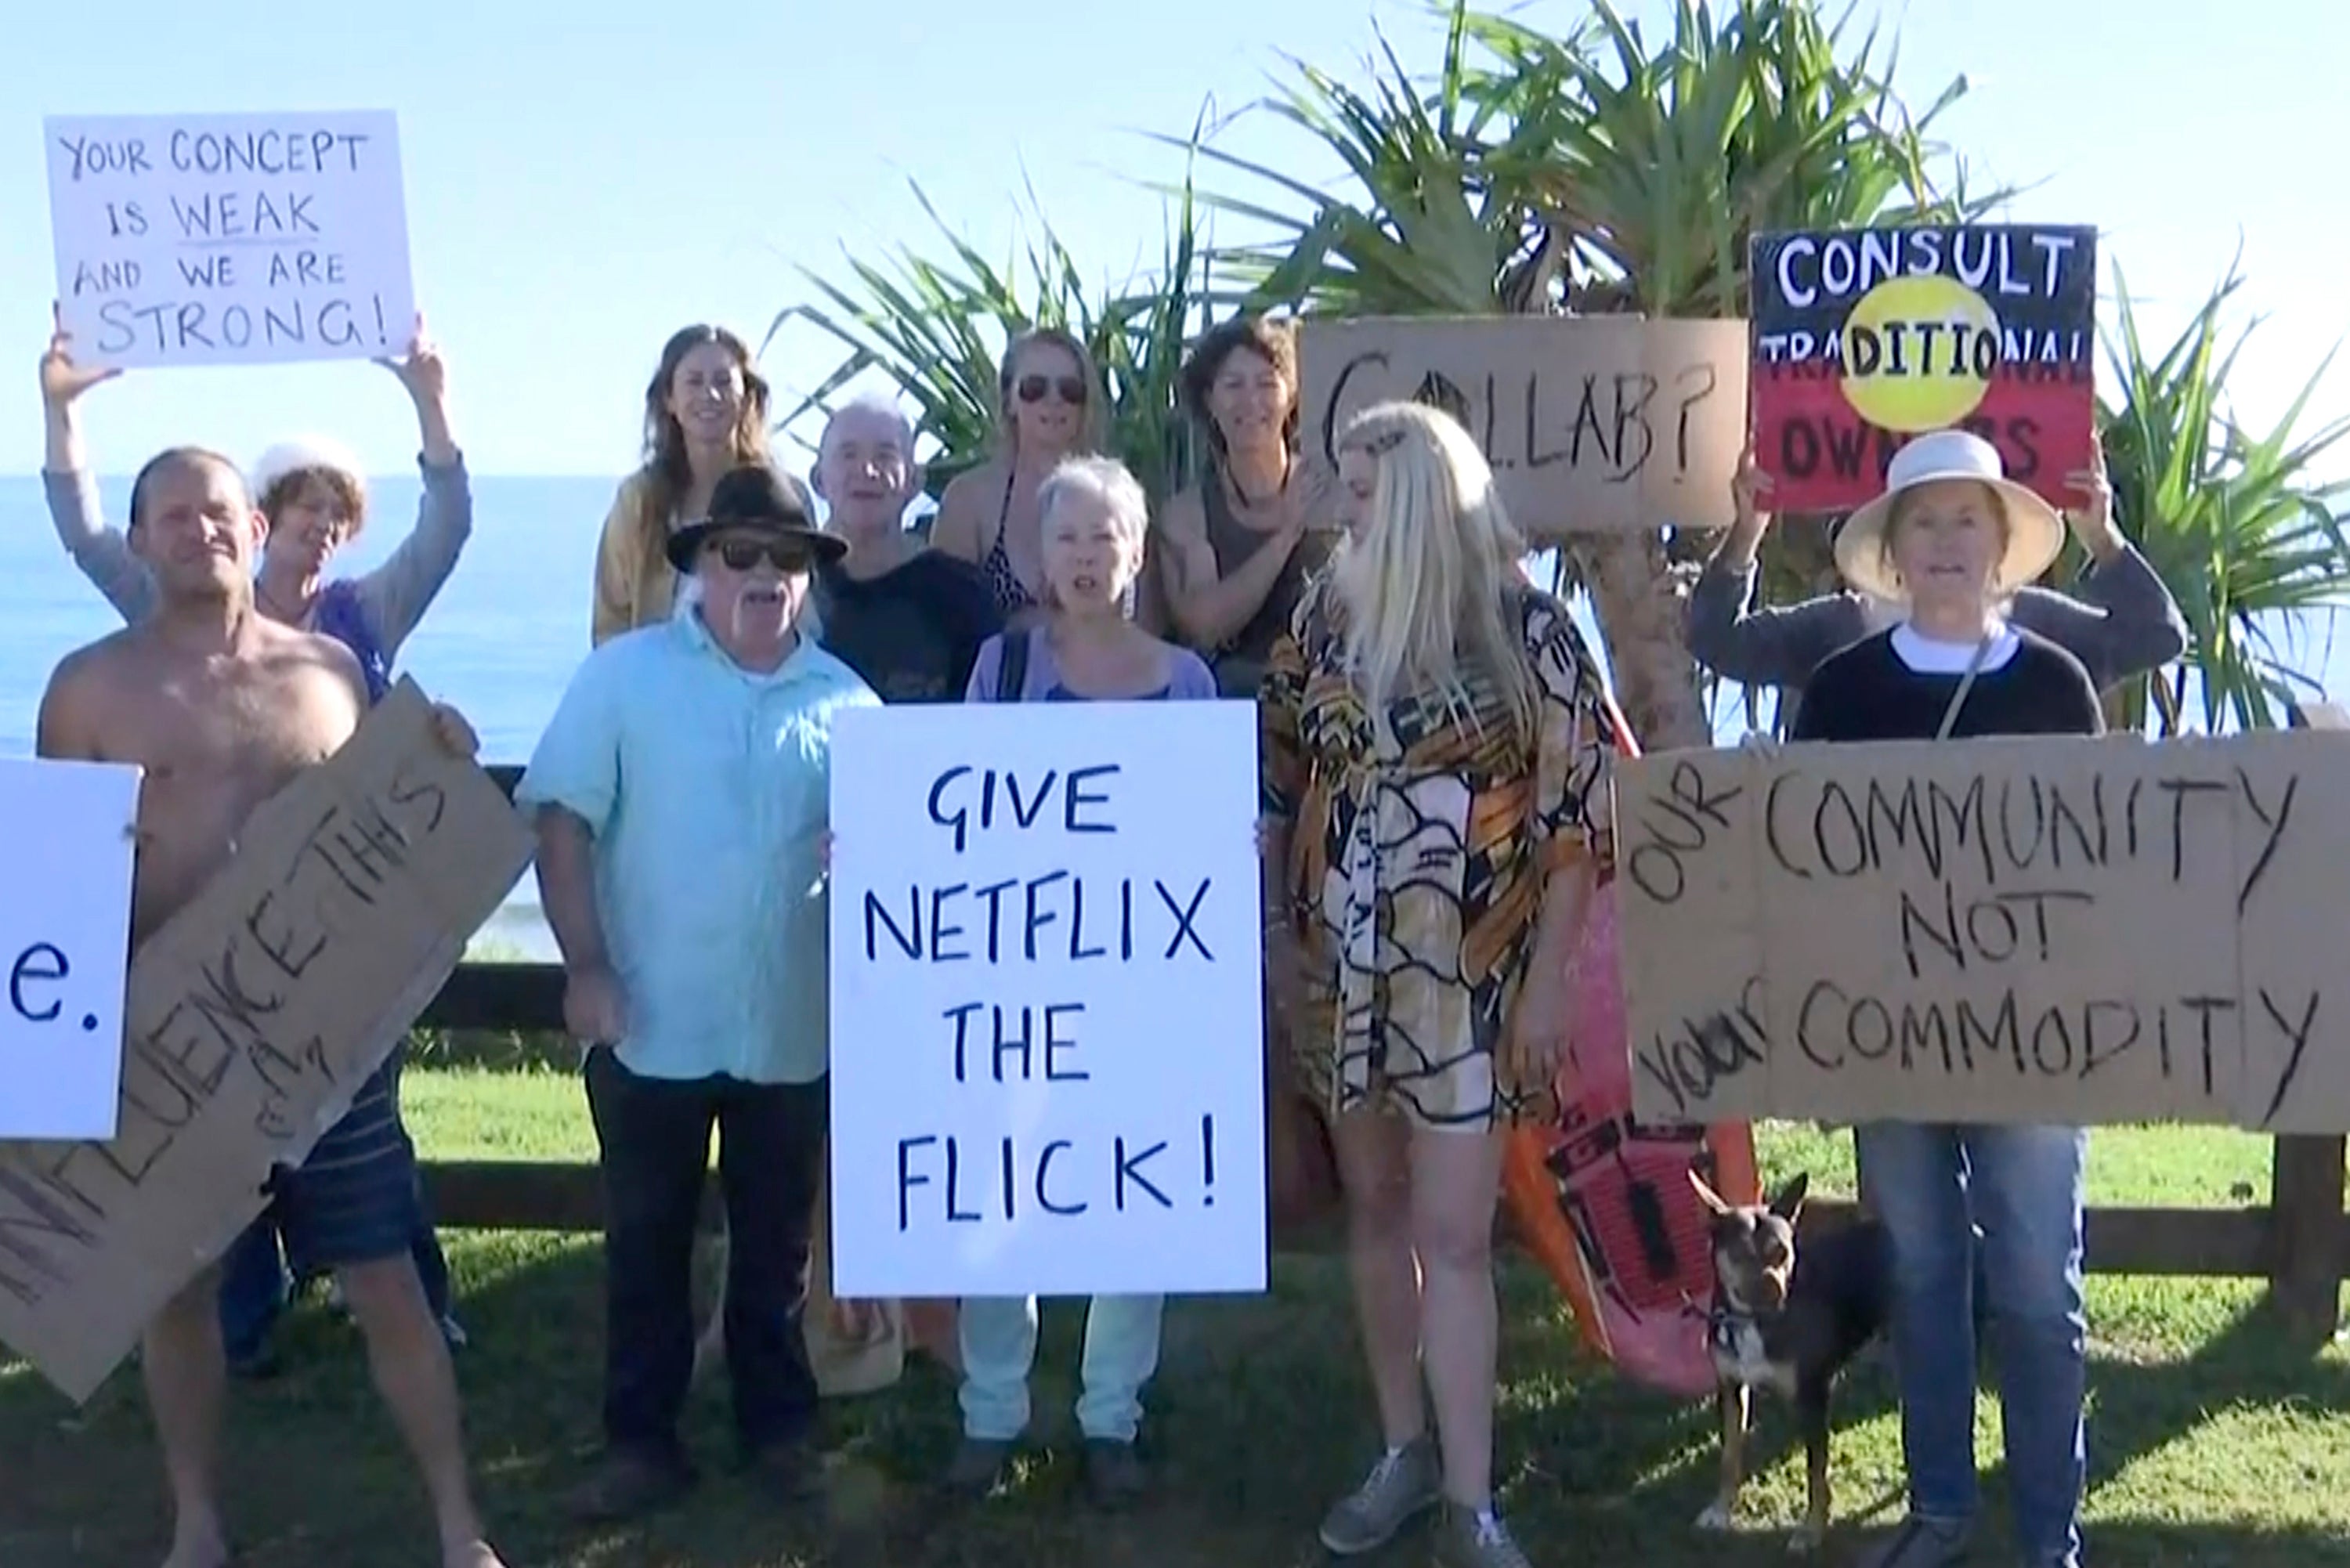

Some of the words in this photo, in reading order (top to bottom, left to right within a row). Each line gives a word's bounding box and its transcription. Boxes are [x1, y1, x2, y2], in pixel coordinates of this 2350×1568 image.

[60, 135, 153, 181] YOUR
[170, 129, 368, 175] CONCEPT
[107, 202, 149, 236] IS
[171, 191, 320, 236] WEAK
[74, 260, 142, 296] AND
[177, 255, 235, 288] WE
[269, 251, 345, 287] ARE
[1777, 229, 2074, 307] CONSULT
[97, 294, 387, 353] STRONG!
[1759, 321, 2090, 381] TRADITIONAL
[284, 776, 446, 904] THIS
[927, 764, 1120, 854] GIVE
[1630, 761, 1742, 904] OUR
[1766, 766, 2298, 915] COMMUNITY
[864, 870, 1215, 964] NETFLIX
[1900, 882, 2095, 979] NOT
[943, 1003, 1090, 1082] THE
[1798, 981, 2319, 1128] COMMODITY
[898, 1113, 1215, 1232] FLICK!
